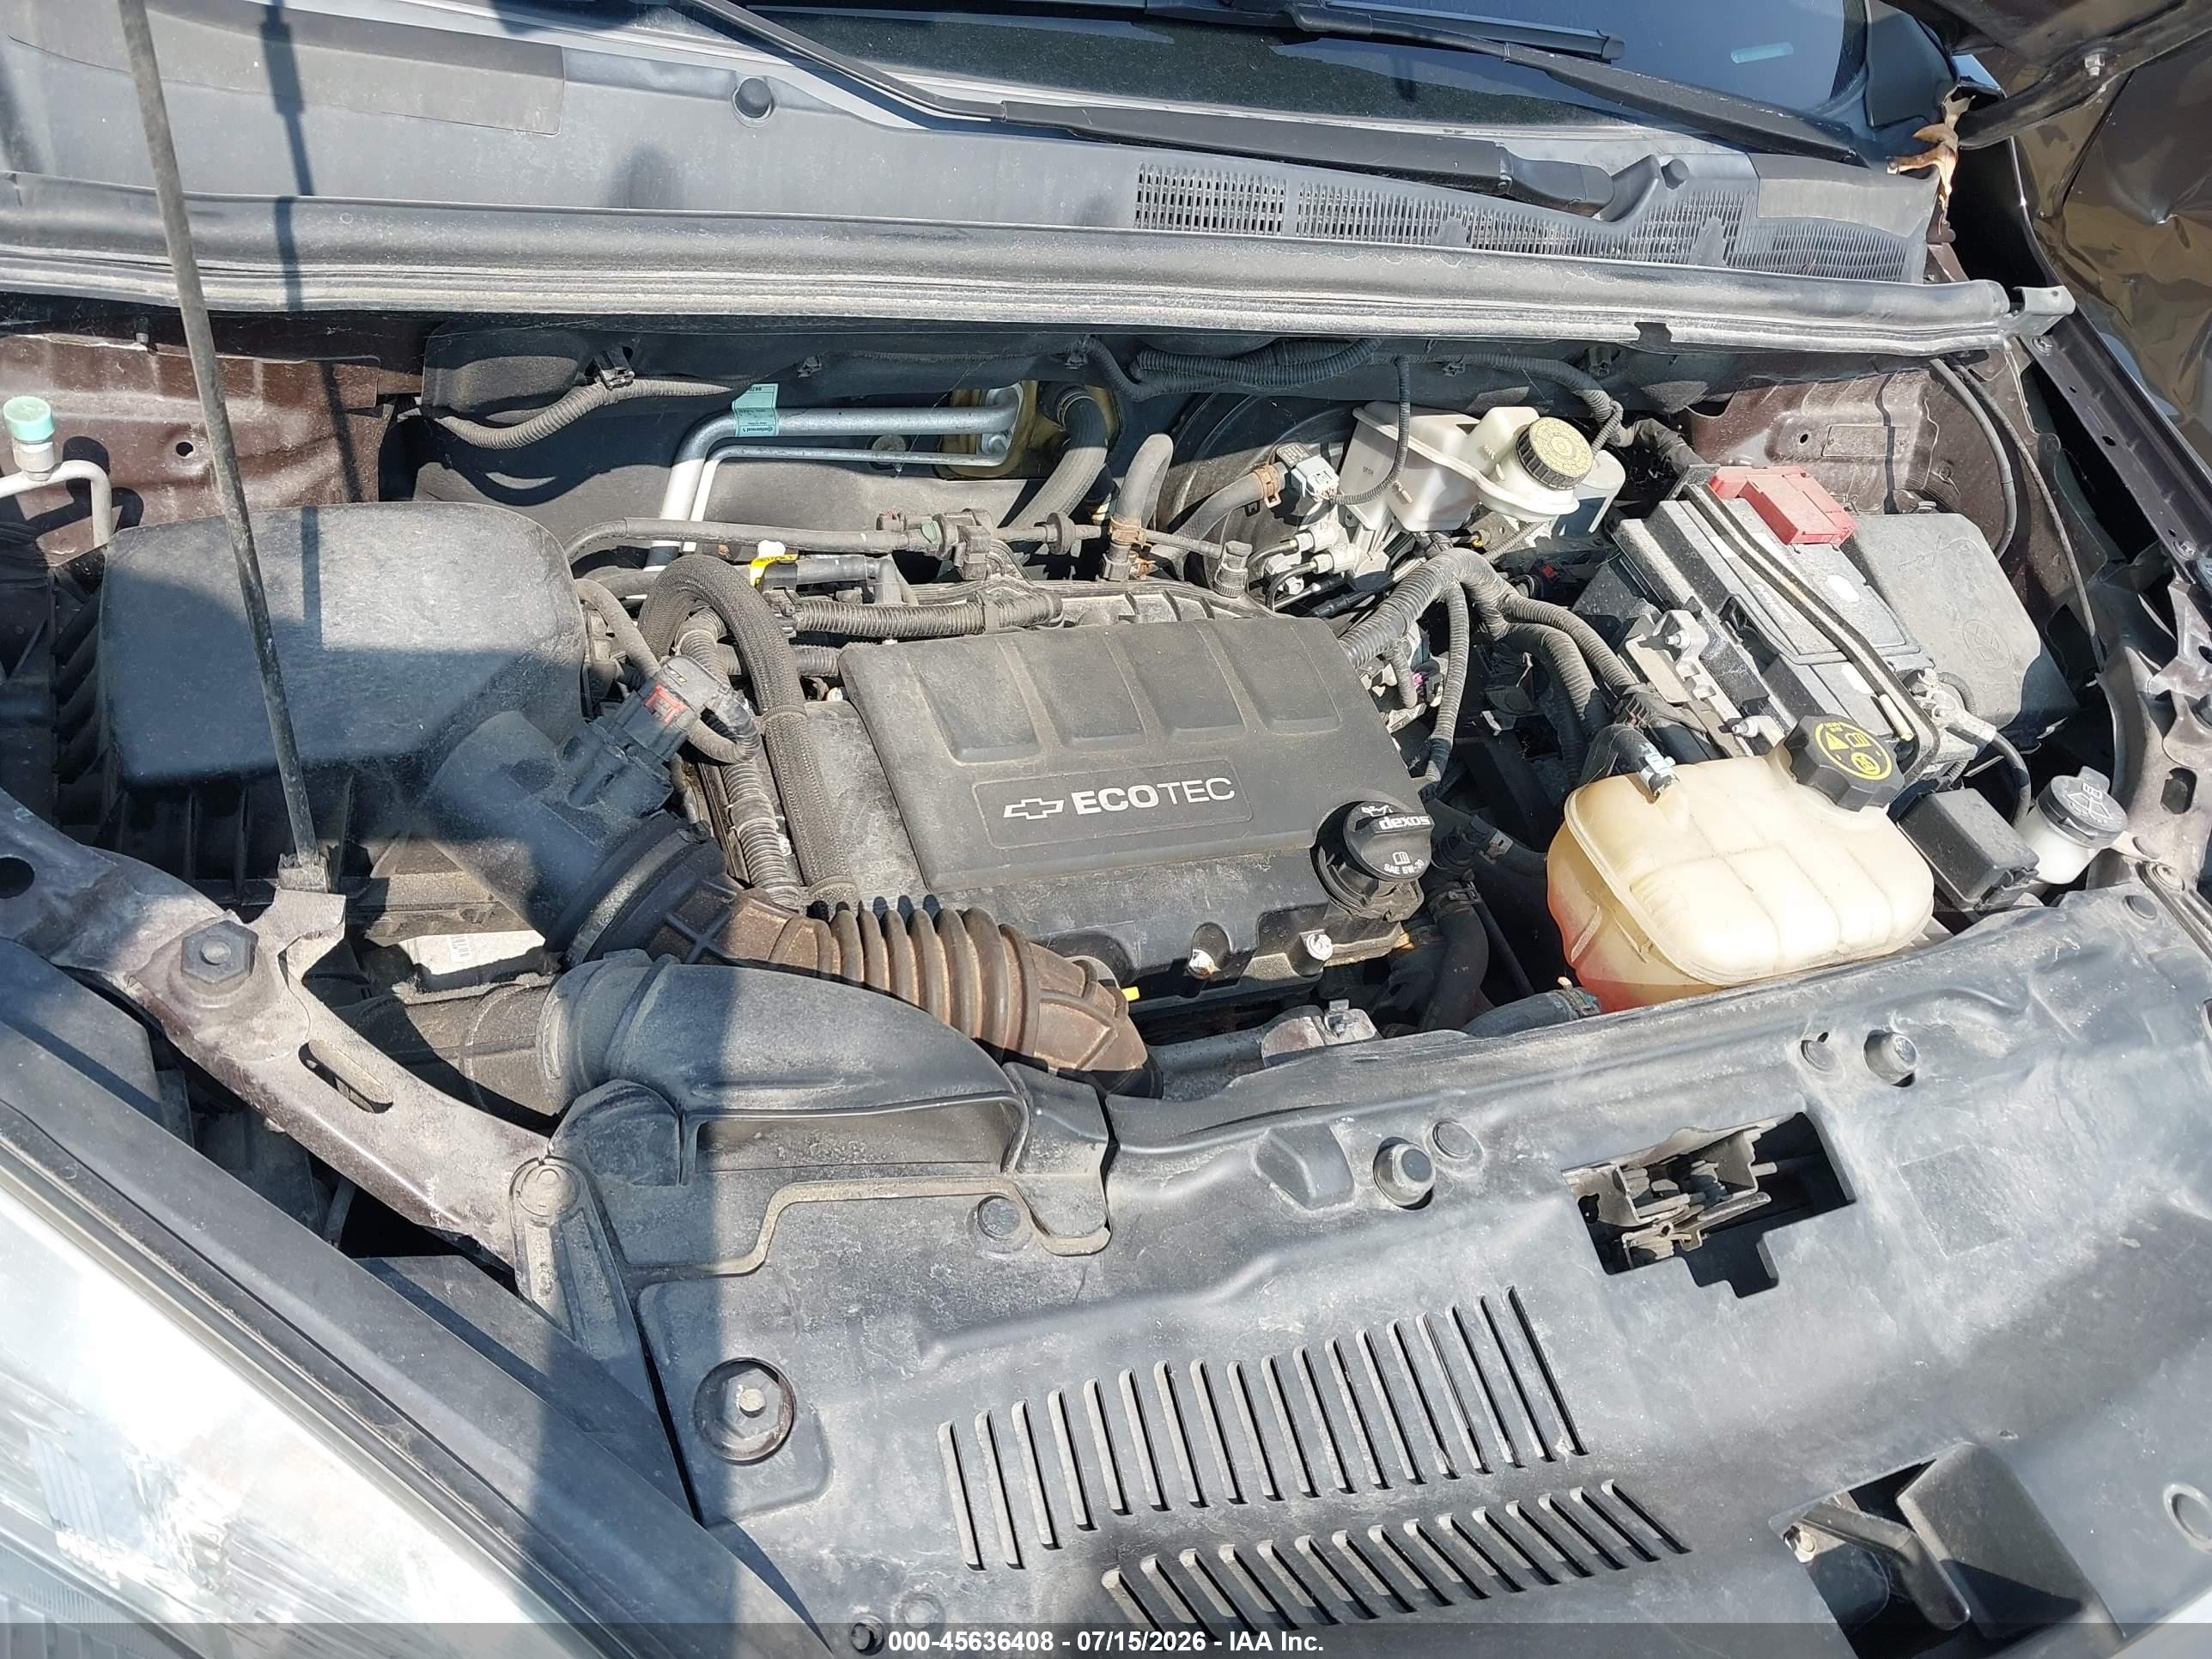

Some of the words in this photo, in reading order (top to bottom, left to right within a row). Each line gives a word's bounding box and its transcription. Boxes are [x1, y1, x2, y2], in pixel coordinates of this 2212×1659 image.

[1071, 777, 1236, 815] ECOTEC
[1378, 816, 1431, 830] dexos
[1383, 863, 1401, 874] SAE
